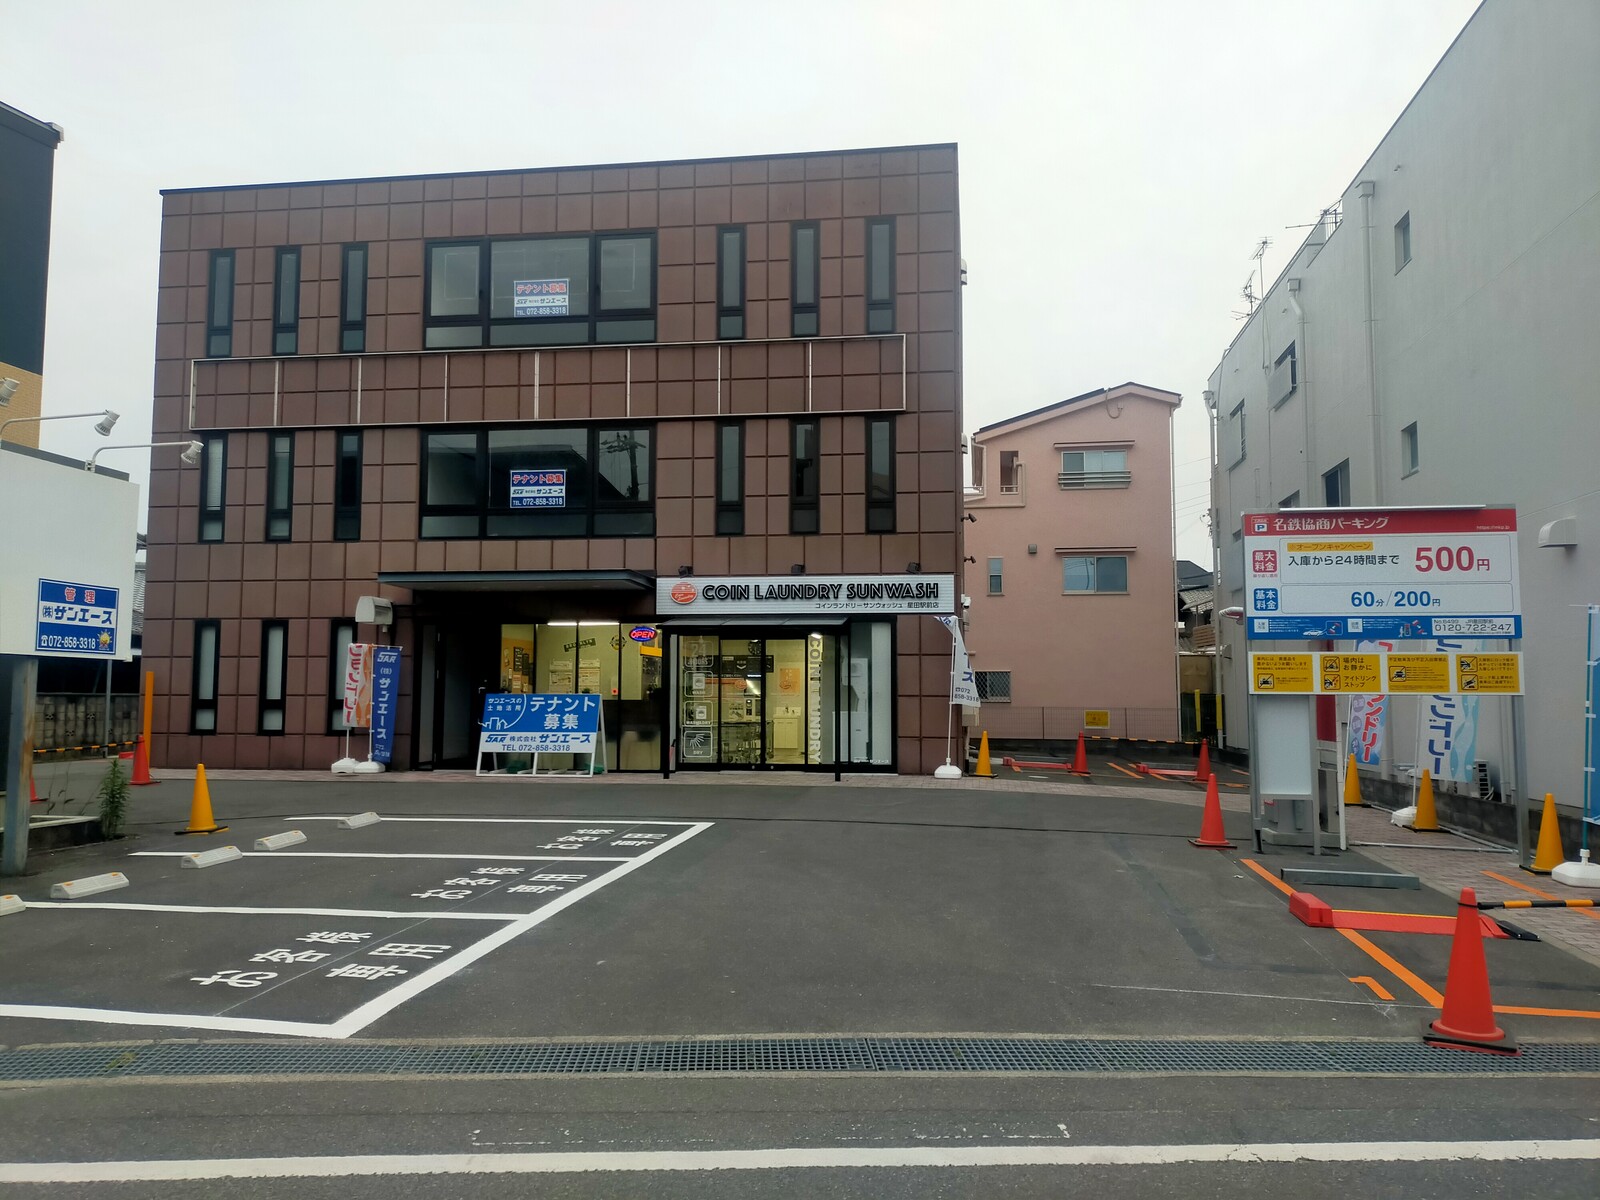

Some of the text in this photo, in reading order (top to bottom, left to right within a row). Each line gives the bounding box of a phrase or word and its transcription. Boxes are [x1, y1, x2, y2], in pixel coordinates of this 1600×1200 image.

[517, 283, 567, 294] テナント募集
[527, 307, 567, 315] 072-858-3318
[513, 473, 564, 484] テナント募集
[523, 498, 563, 506] 072-858-3318
[1273, 517, 1390, 531] 名鉄協商パーキング
[1296, 543, 1371, 551] オープンキャンペーン
[1288, 555, 1400, 566] 入庫から24時間まで
[64, 587, 96, 604] 管理
[702, 582, 939, 600] COIN LAUNDRY SUNWASH
[907, 601, 939, 609] 星田駅前店
[1434, 624, 1512, 632] 0120-722-247
[630, 630, 656, 639] OPEN
[48, 635, 96, 649] 072-858-3318
[809, 640, 821, 678] COIN
[530, 696, 596, 712] テナント
[543, 713, 579, 730] 募集
[539, 734, 591, 743] サンエース
[518, 744, 571, 752] 072-858-3318
[411, 866, 526, 900] お客様
[190, 930, 373, 989] お客様
[326, 942, 452, 981] 専用
